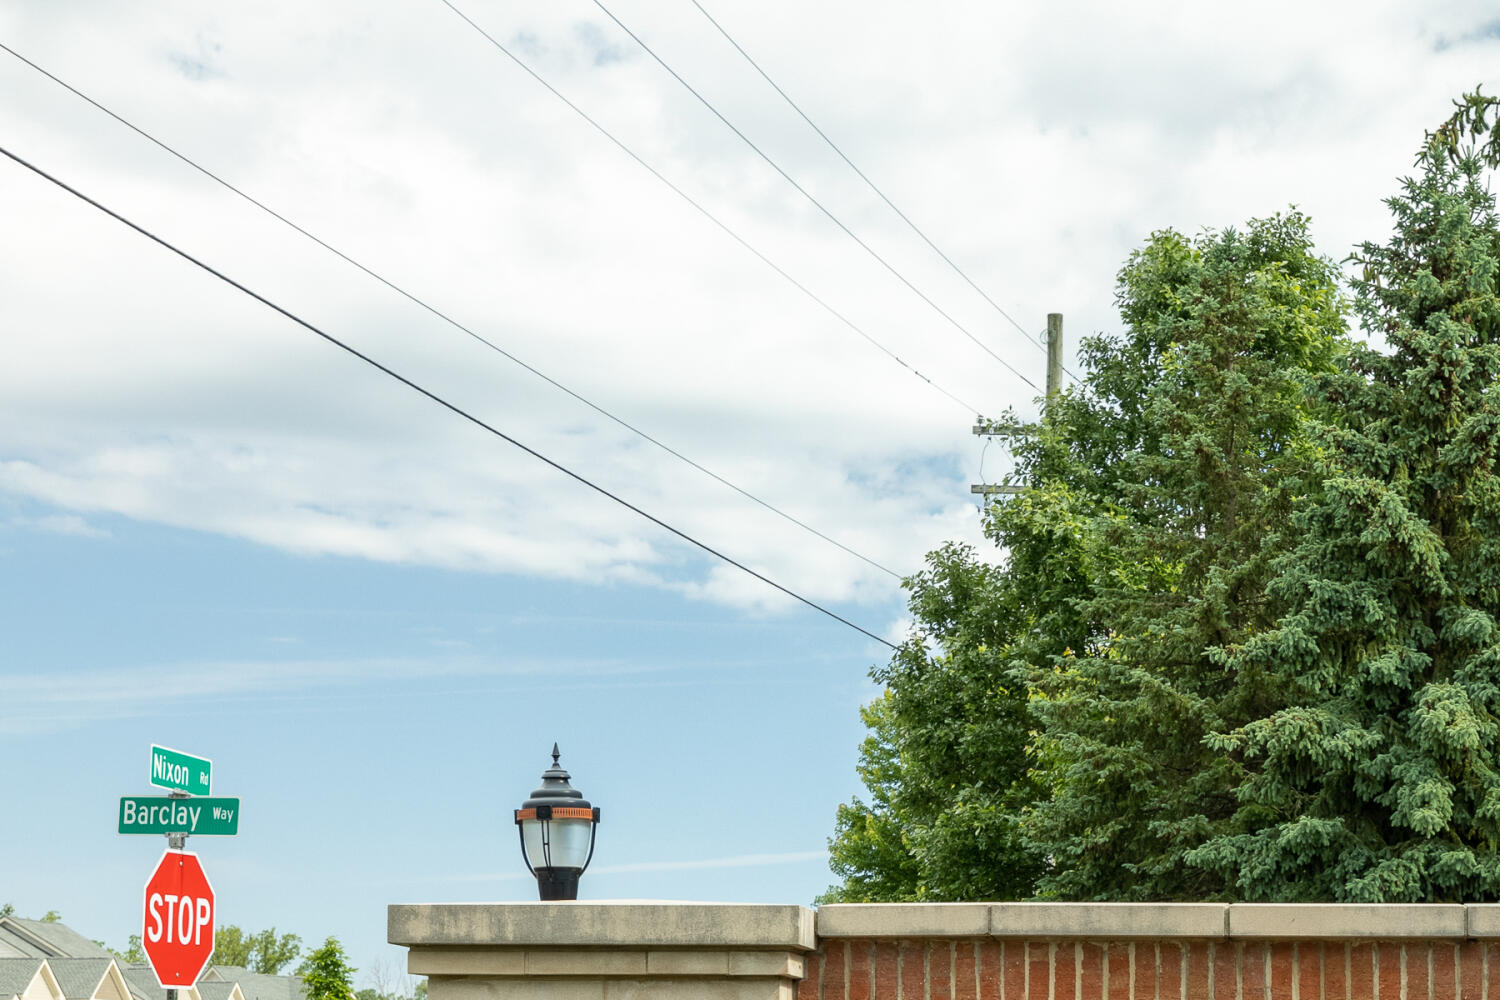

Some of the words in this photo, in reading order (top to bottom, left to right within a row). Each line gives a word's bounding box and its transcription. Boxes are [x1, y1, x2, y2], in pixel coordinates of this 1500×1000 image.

[153, 752, 189, 787] Nixon
[200, 771, 209, 786] Rd
[123, 800, 201, 831] Barclay
[212, 807, 234, 823] Way
[147, 892, 211, 946] STOP
